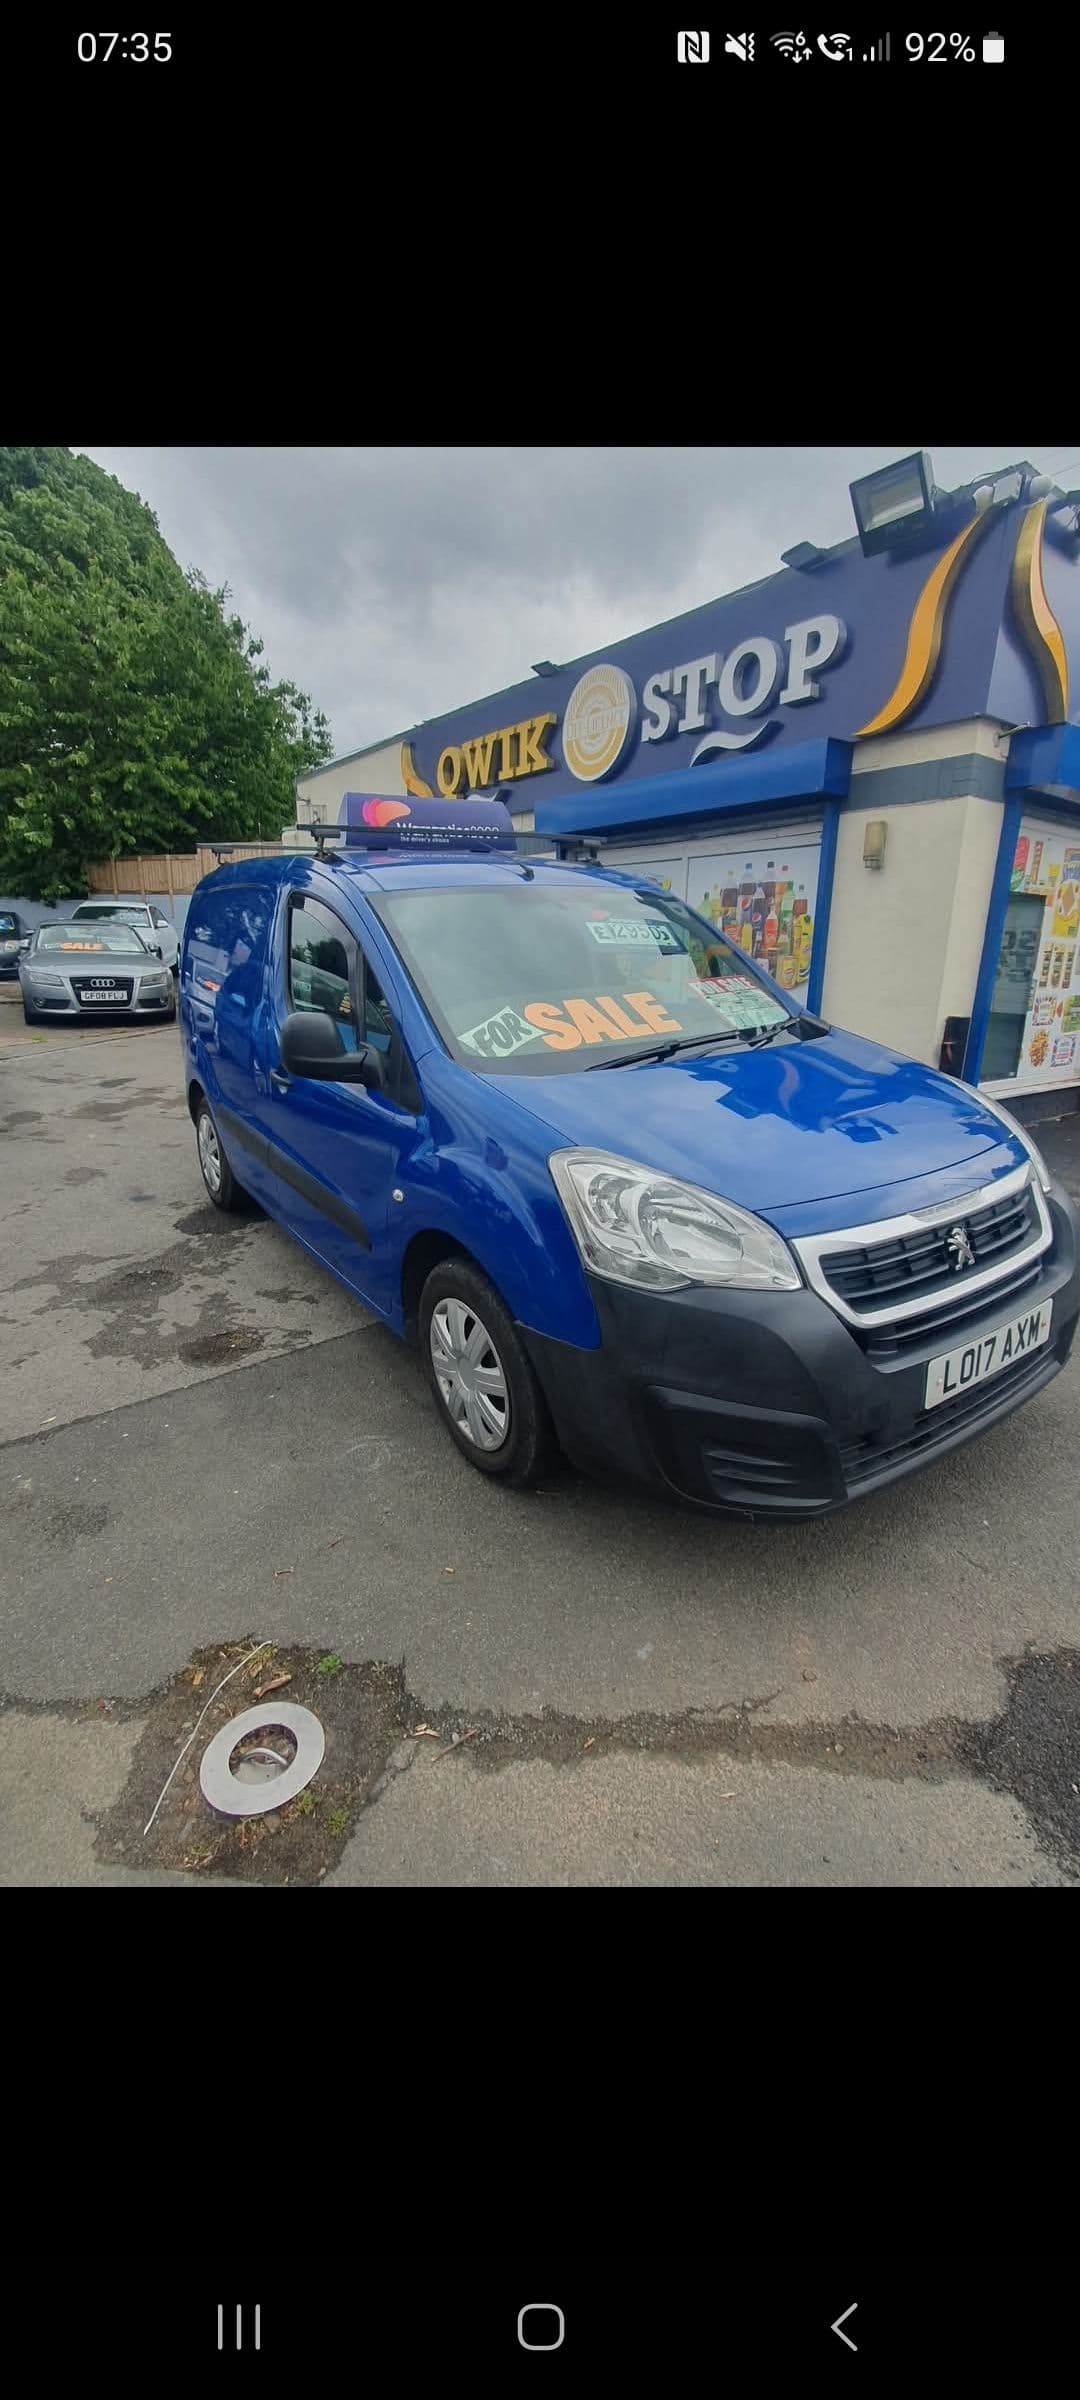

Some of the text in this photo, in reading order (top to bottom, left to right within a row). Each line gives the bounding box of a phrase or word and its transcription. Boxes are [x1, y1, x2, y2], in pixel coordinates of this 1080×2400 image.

[437, 614, 846, 799] QWIK STOP
[63, 942, 104, 950] SALE
[472, 1012, 534, 1056] FOR
[524, 992, 683, 1050] SALE
[943, 1311, 1041, 1394] LO17 AXM
